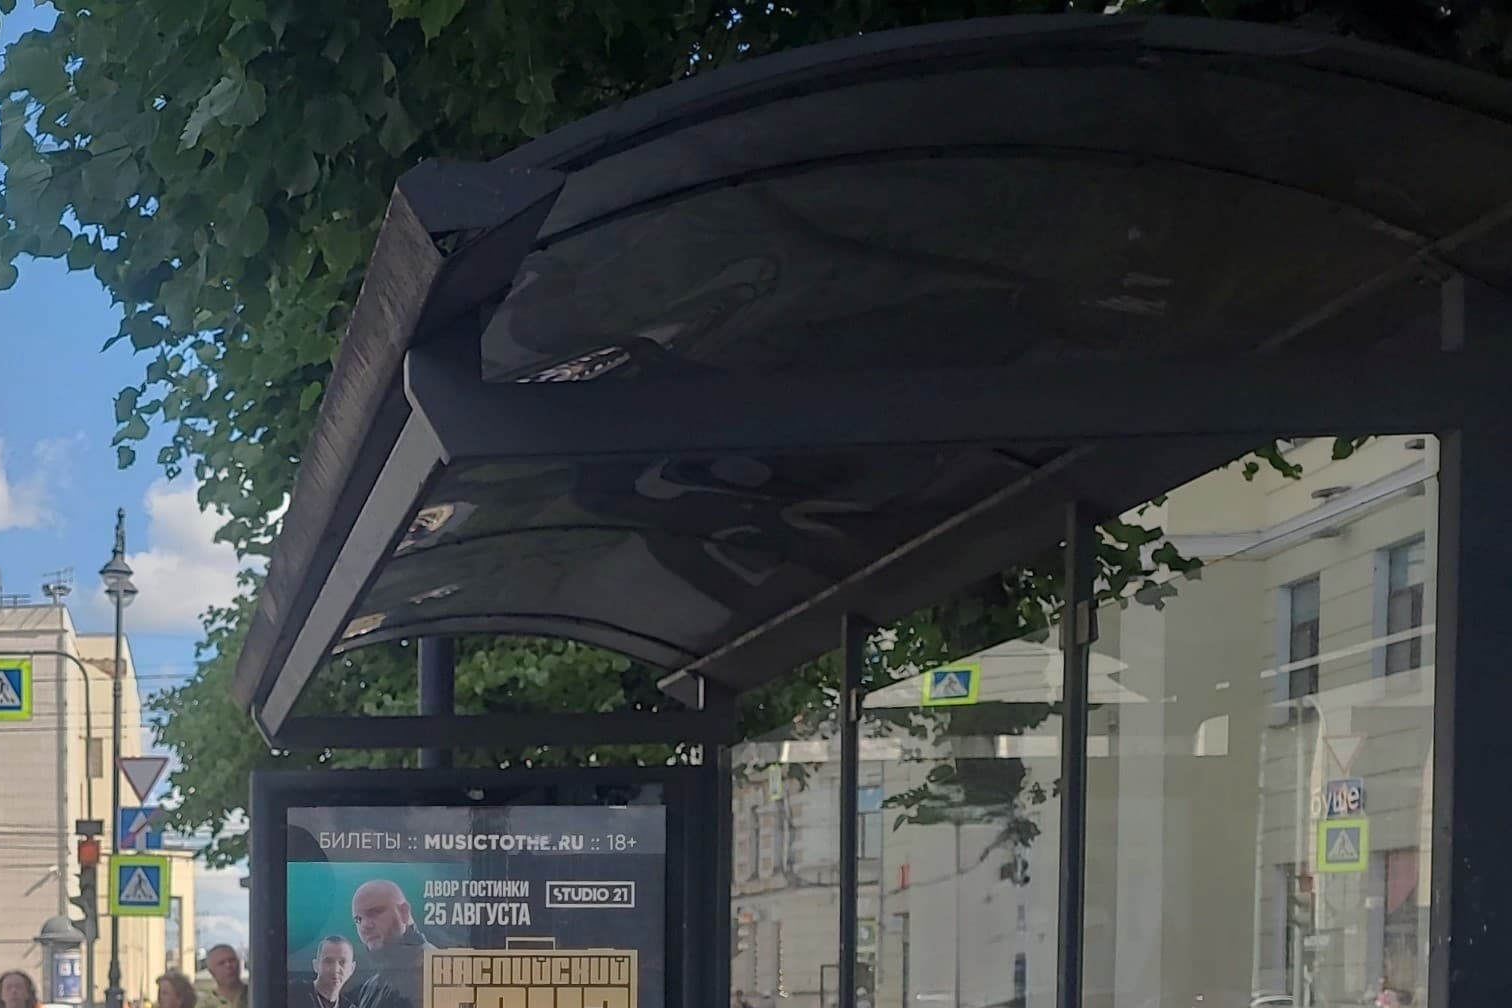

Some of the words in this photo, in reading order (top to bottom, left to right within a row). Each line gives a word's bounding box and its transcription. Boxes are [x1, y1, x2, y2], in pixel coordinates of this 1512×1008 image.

[1311, 787, 1359, 820] буше
[319, 832, 401, 849] БИЛЕТЫ
[424, 834, 584, 850] MUSICTOTHE.RU
[606, 834, 638, 850] 18+
[423, 881, 458, 899] ДВОР
[462, 880, 529, 898] ГОСТИНКИ
[552, 887, 609, 902] STUDIO
[613, 887, 629, 902] 21
[424, 903, 447, 925] 25
[451, 902, 531, 926] АВГУСТА
[433, 956, 629, 985] КАСПИЙСКИЙ
